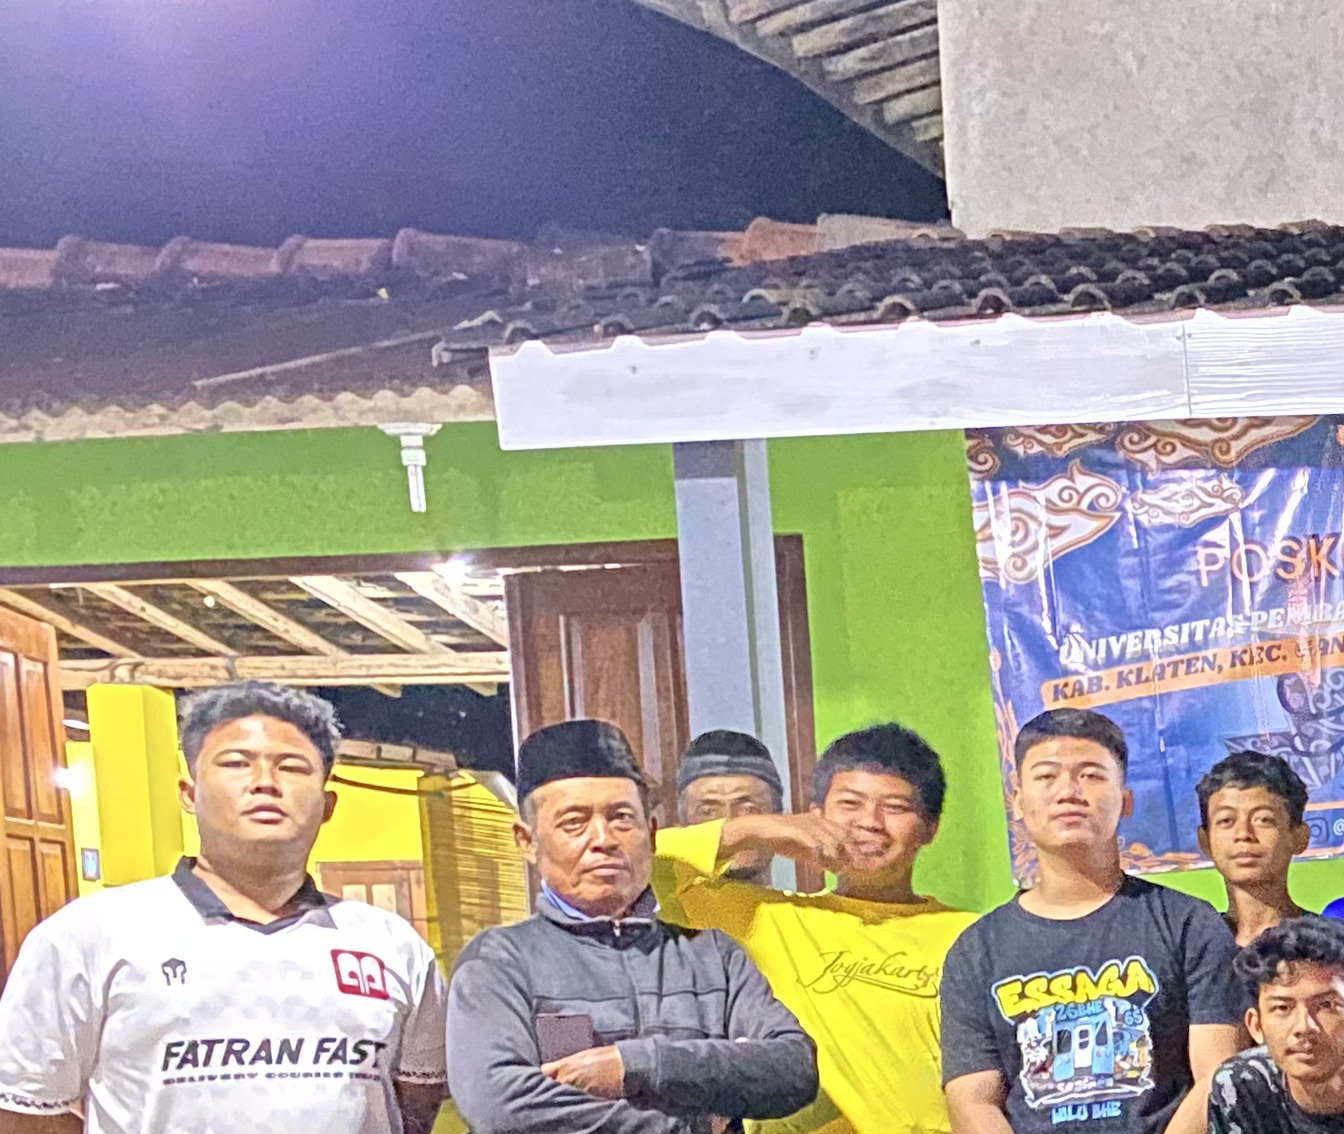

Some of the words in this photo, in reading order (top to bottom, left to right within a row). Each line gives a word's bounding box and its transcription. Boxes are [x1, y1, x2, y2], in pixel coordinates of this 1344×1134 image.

[1052, 676, 1110, 702] KAB.
[997, 960, 1155, 1018] ESSAGA
[161, 1038, 304, 1072] FATRAN
[312, 1037, 387, 1068] FAST
